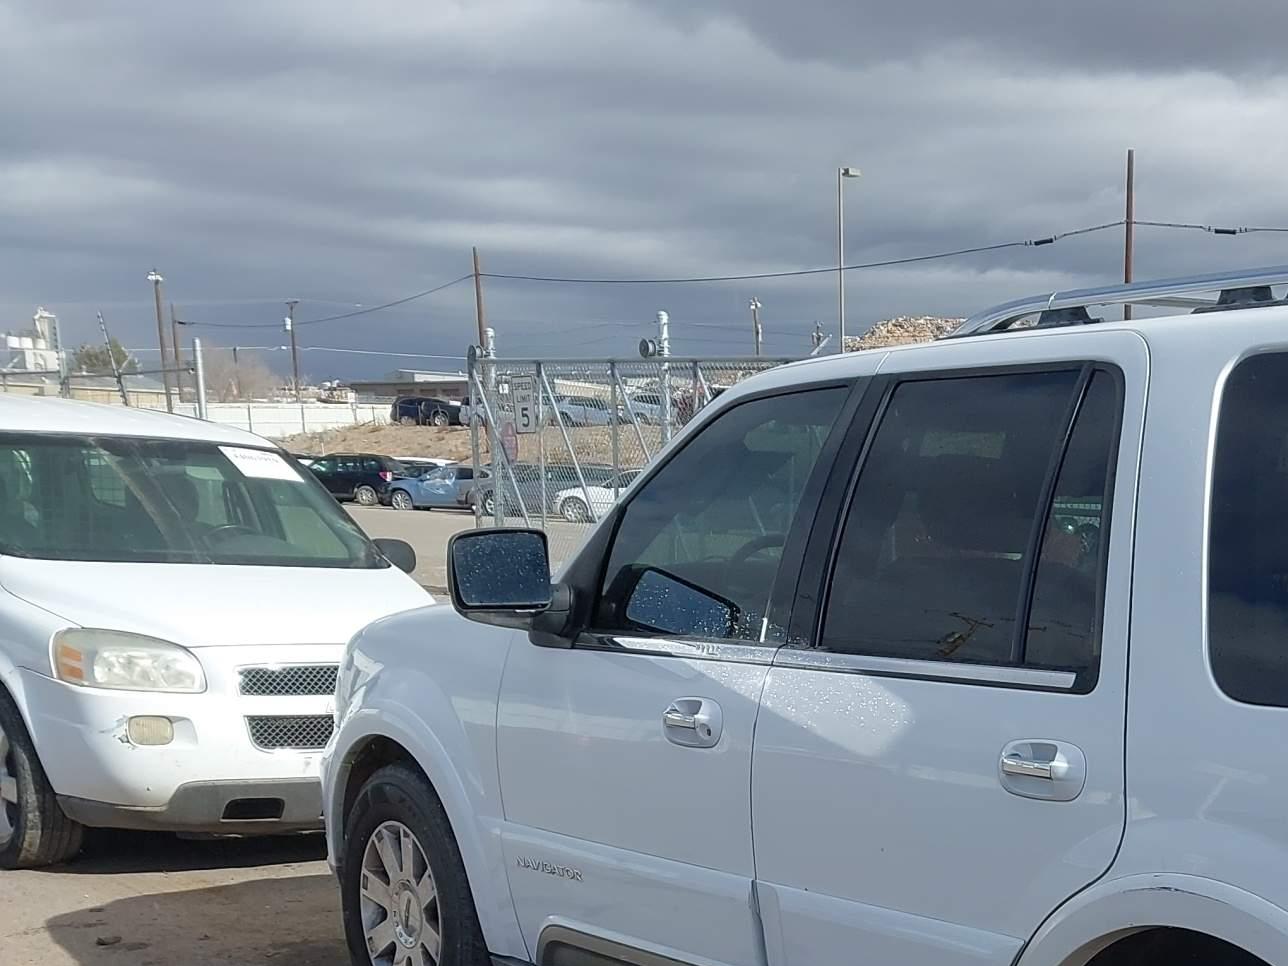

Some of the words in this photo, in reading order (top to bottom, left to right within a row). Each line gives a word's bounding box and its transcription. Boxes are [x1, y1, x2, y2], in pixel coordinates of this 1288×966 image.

[512, 382, 531, 391] SPEED
[516, 394, 530, 403] LIMIT
[521, 407, 530, 427] 5
[516, 855, 583, 881] NAVIGATOR
